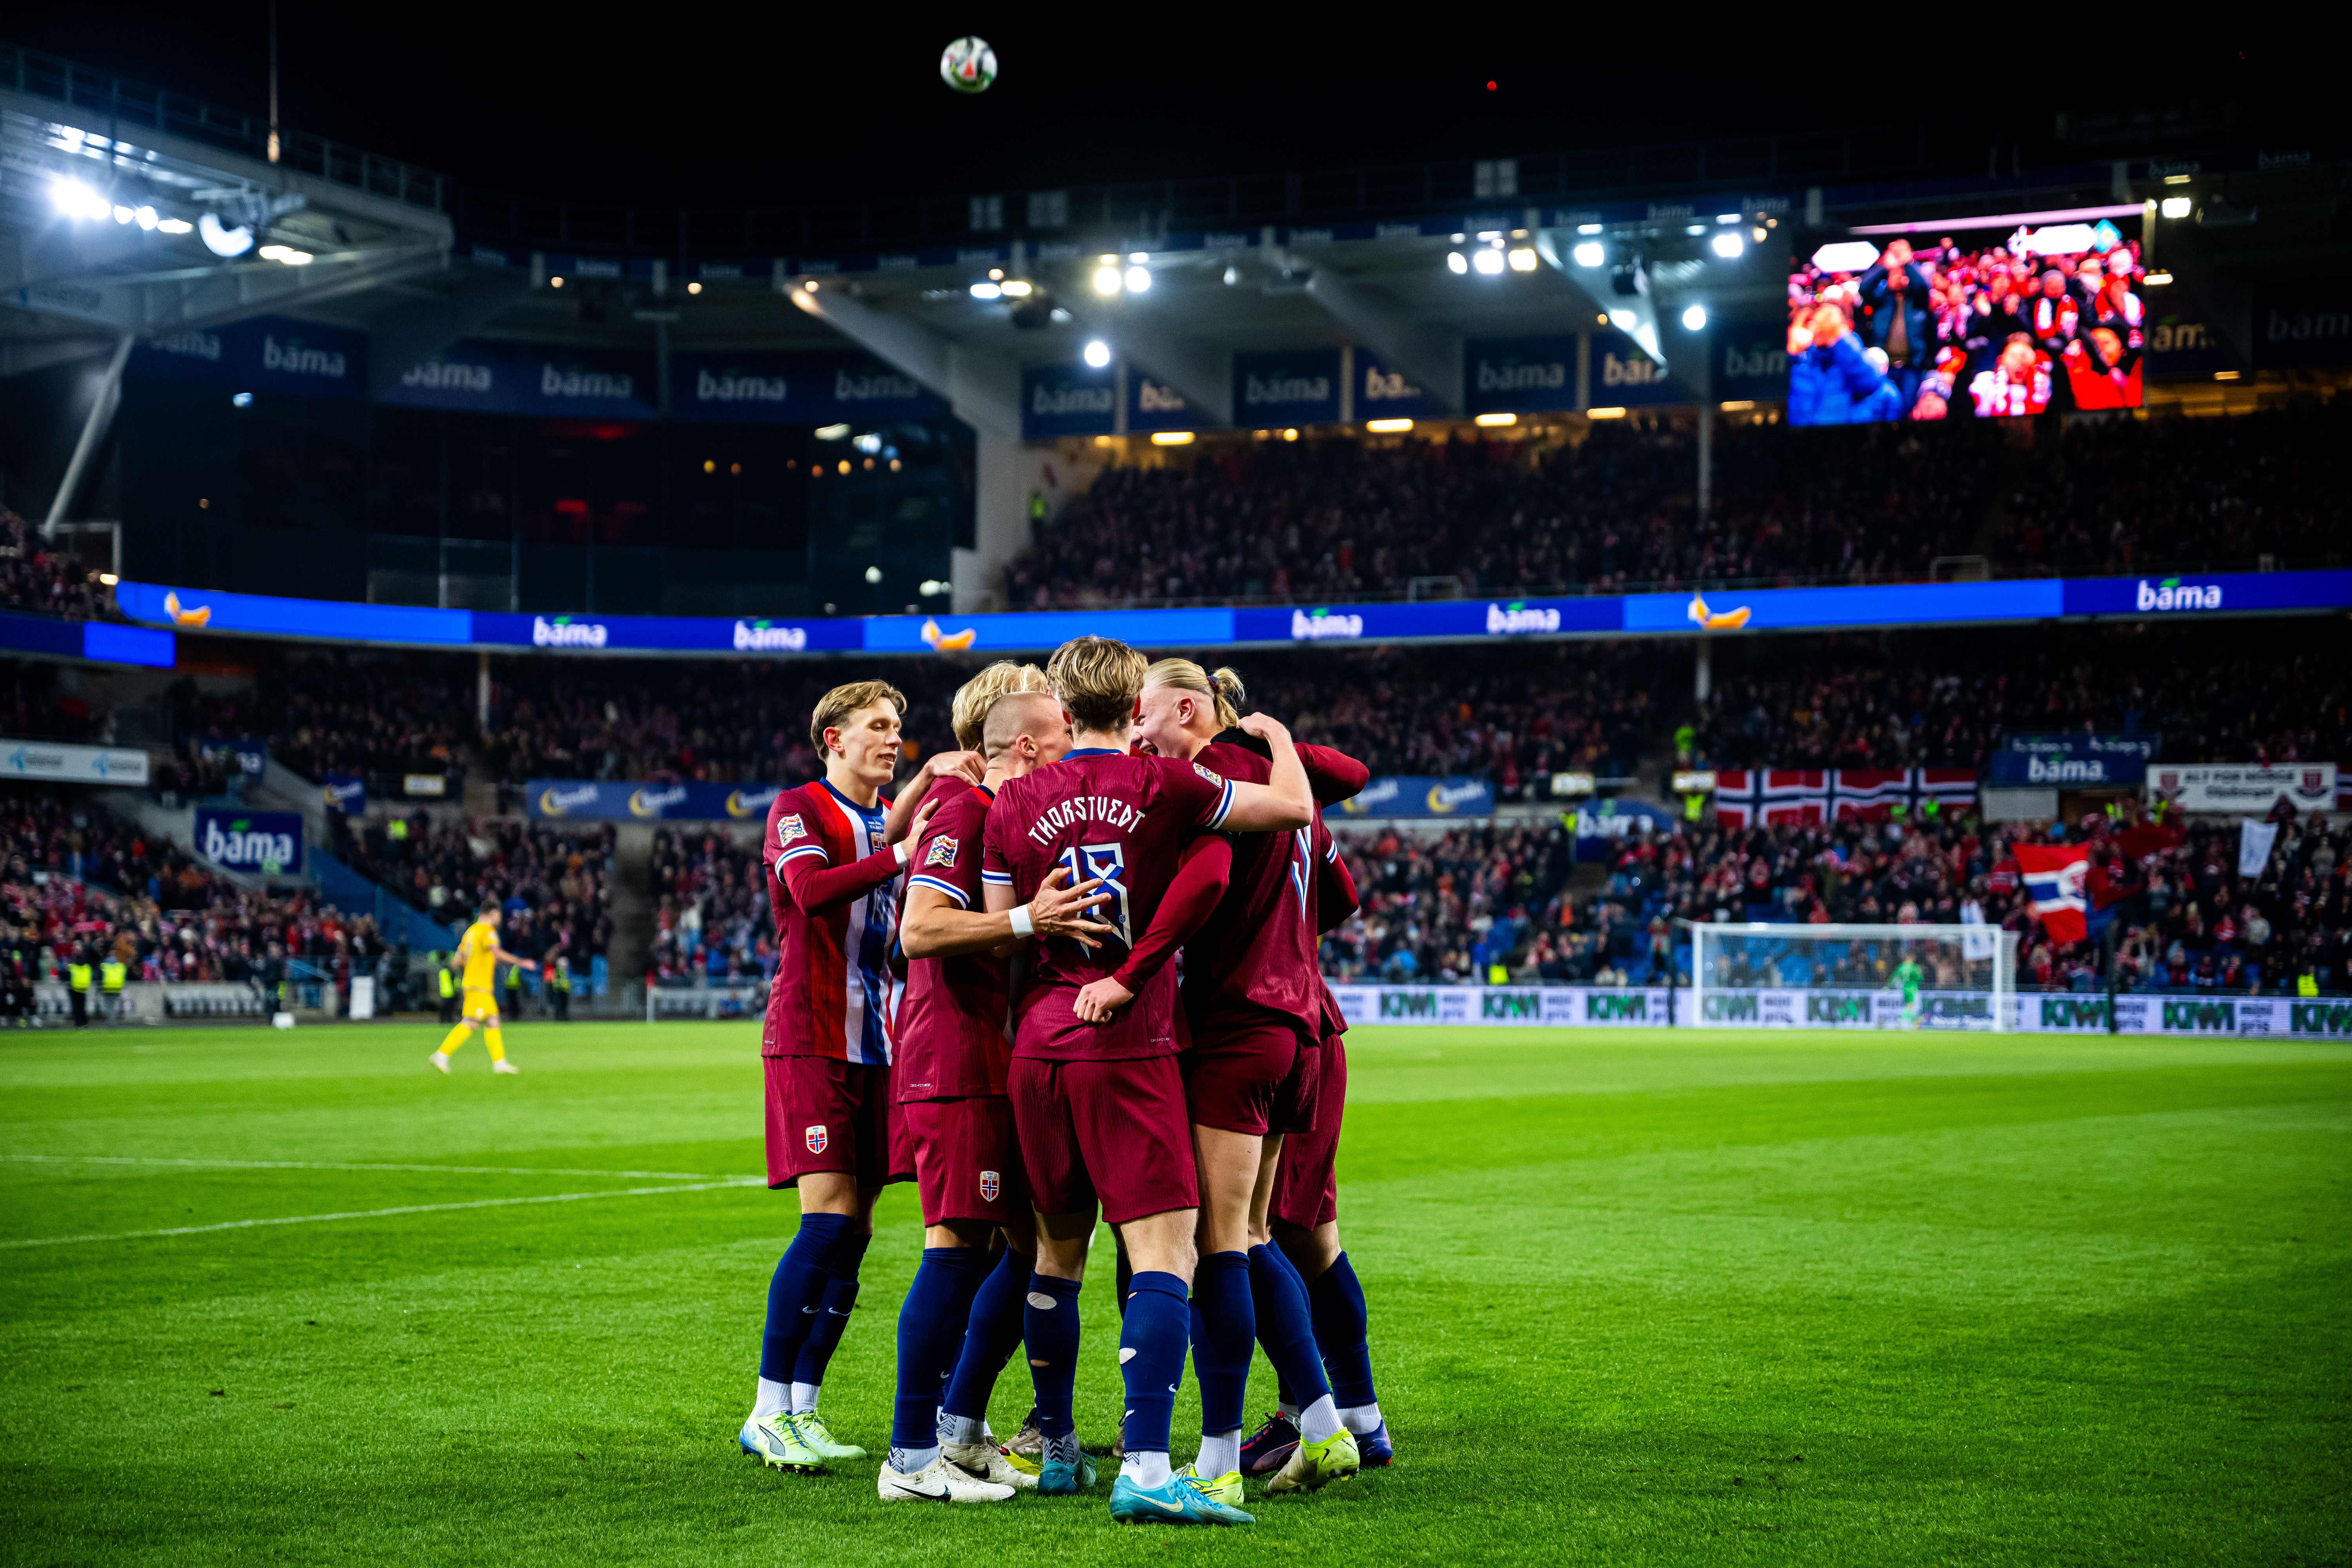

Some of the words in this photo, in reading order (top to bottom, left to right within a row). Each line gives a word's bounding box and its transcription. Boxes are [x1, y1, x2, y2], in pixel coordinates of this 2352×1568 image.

[264, 334, 346, 379] bama
[696, 367, 787, 402] bama
[2137, 580, 2222, 611] bama
[533, 616, 608, 647] bama
[1292, 609, 1363, 639] bama
[1487, 603, 1561, 633] bama
[733, 620, 807, 650] bama
[2028, 754, 2104, 782] bama
[1028, 796, 1145, 846] THORSTVEDT
[206, 818, 293, 865] bama
[1058, 842, 1132, 959] 18
[2164, 1002, 2234, 1029] KIWI
